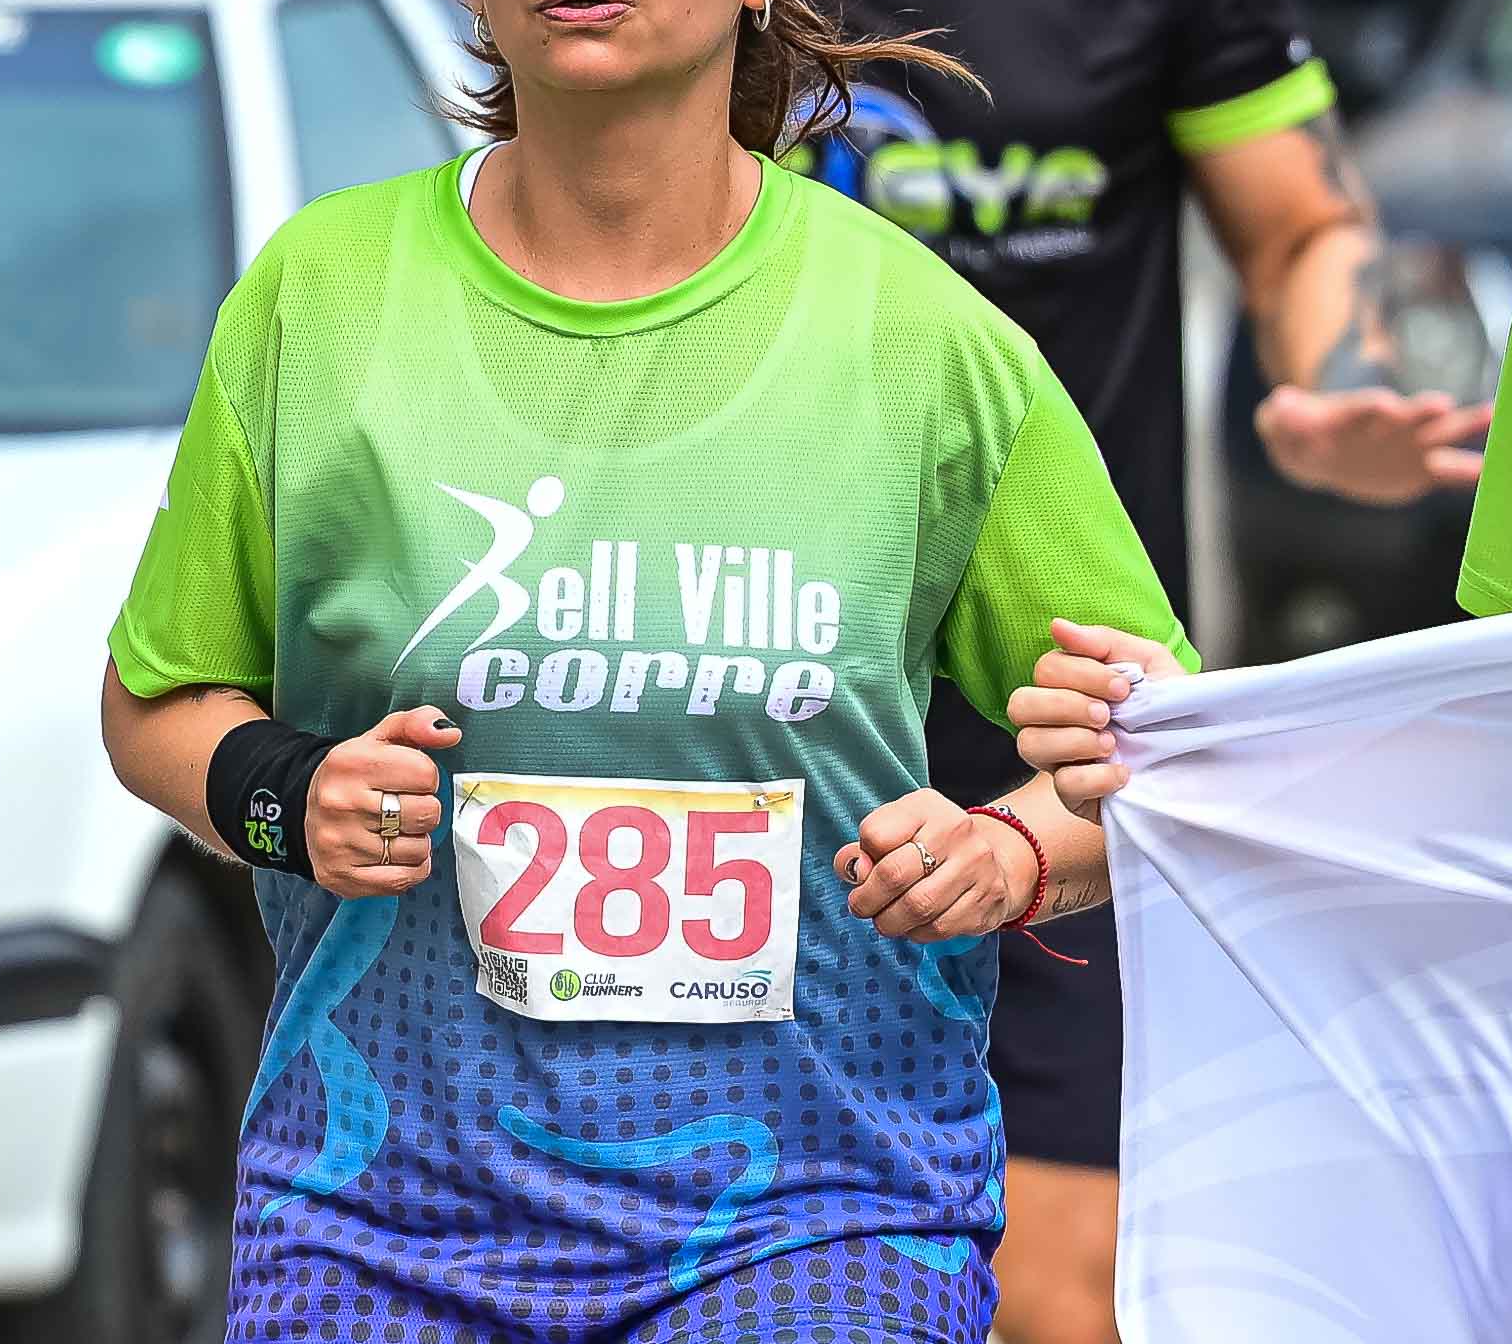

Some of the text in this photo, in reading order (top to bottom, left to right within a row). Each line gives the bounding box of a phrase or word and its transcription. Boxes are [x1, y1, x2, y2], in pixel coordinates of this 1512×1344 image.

[675, 542, 842, 655] Ville
[456, 648, 836, 723] corre
[477, 800, 773, 961] 285
[582, 985, 644, 997] RUNNER'S
[584, 973, 616, 985] CLUB
[669, 982, 769, 1000] CARUSO
